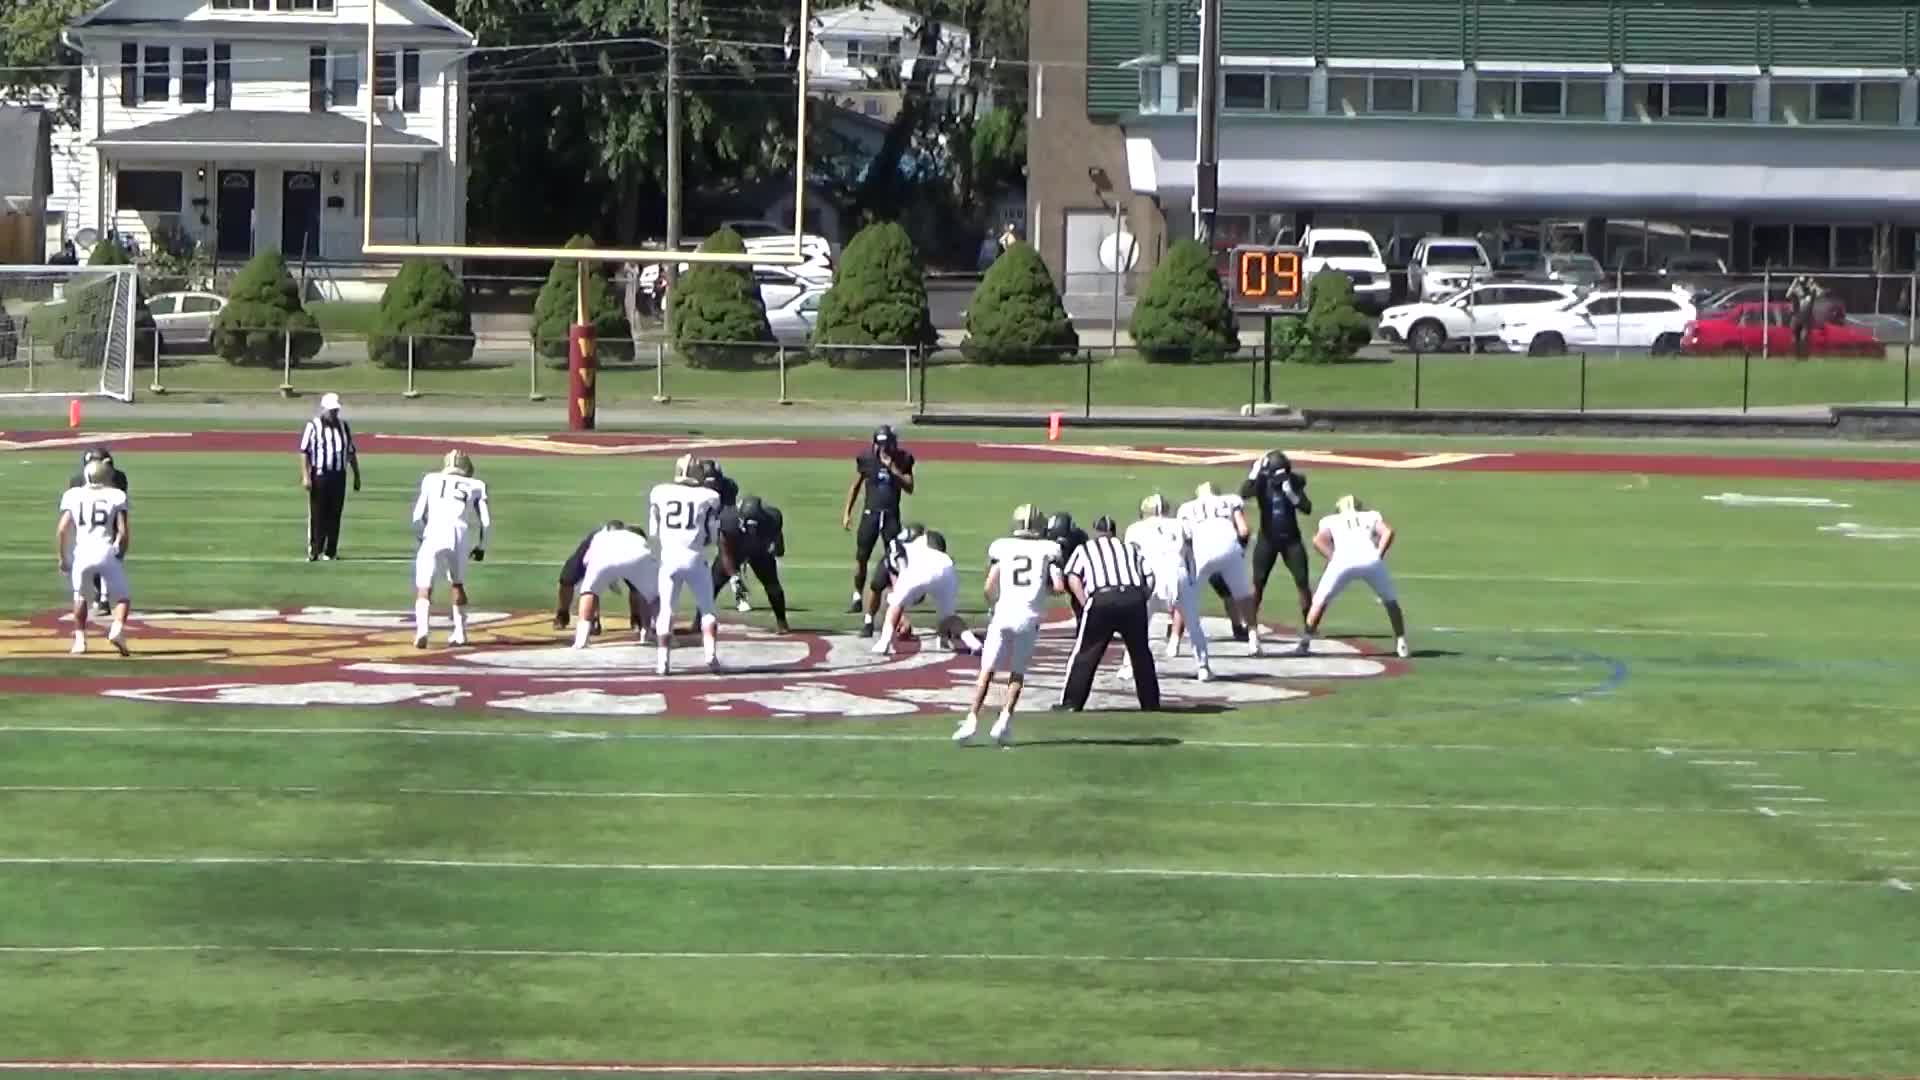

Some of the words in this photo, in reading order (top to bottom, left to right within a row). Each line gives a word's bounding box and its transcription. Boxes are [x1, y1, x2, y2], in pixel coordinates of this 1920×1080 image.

[1241, 251, 1299, 296] 09
[440, 479, 470, 502] 15
[78, 499, 108, 526] 16
[665, 500, 696, 529] 21
[1012, 554, 1033, 587] 2
